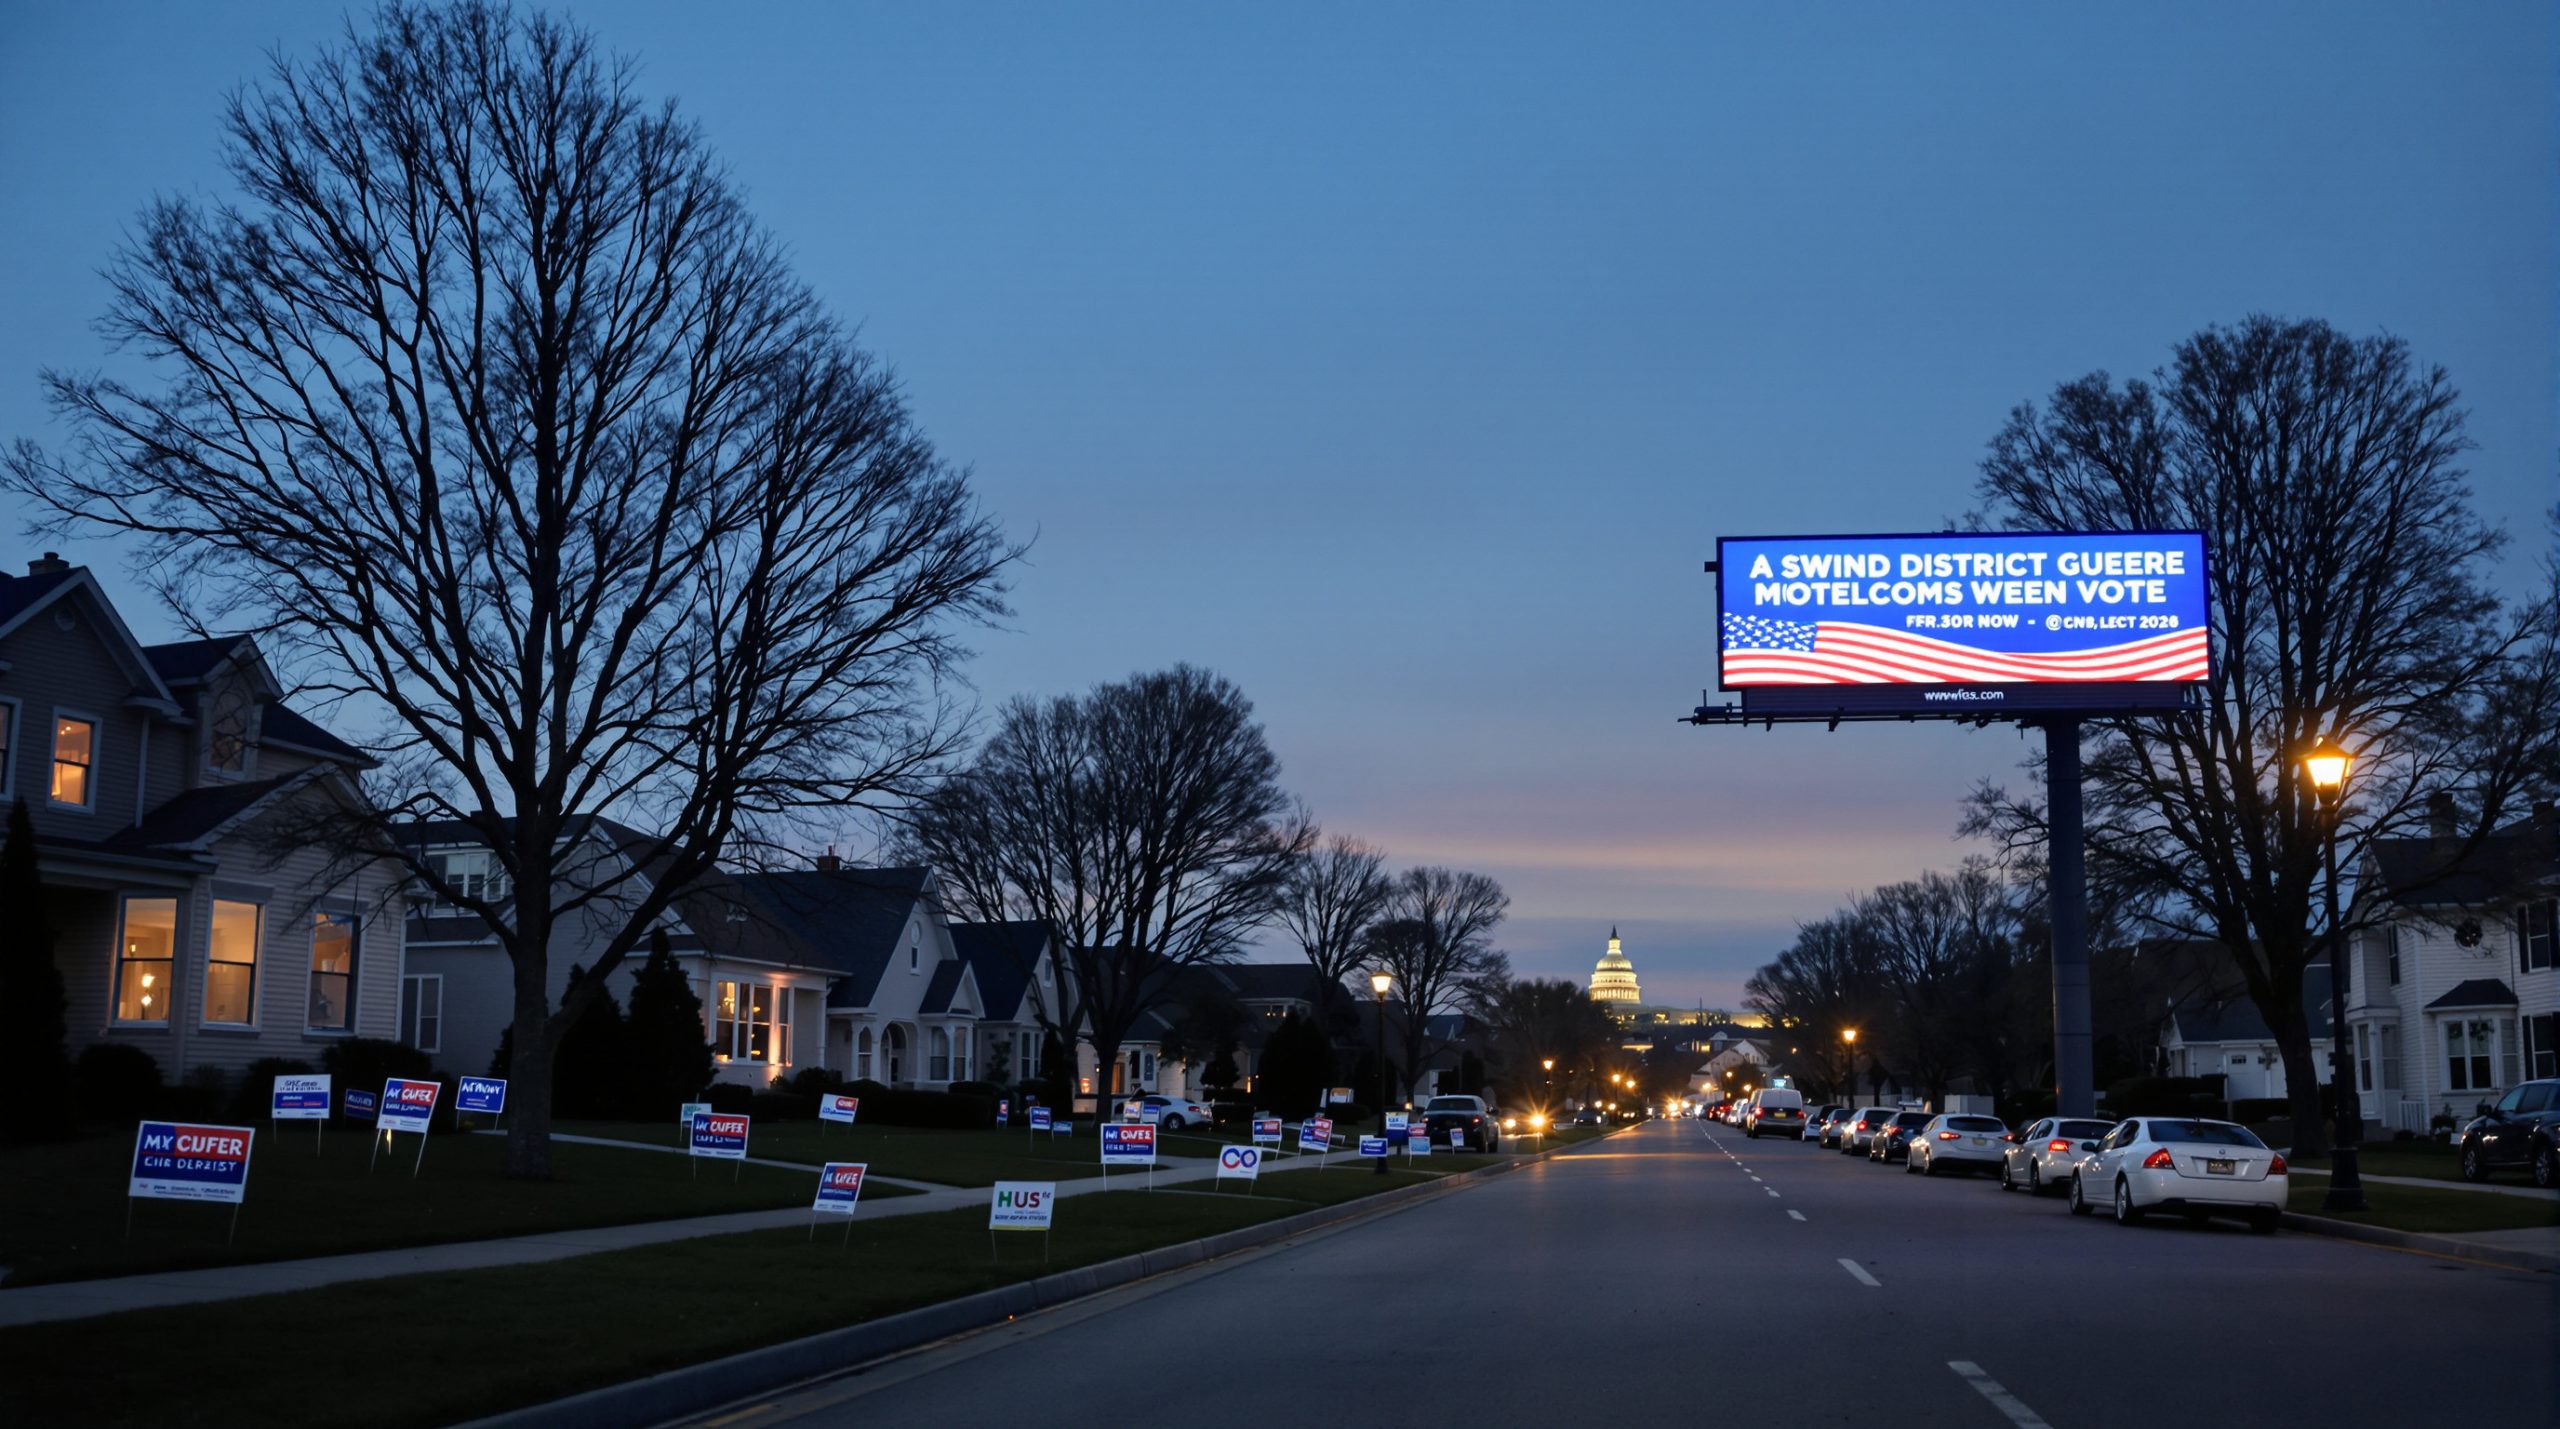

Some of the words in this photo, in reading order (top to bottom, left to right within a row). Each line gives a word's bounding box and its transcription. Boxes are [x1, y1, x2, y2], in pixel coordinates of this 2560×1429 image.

[1749, 553, 1774, 579] A
[1780, 553, 1892, 579] SWIND
[1900, 552, 2048, 578] DISTRICT
[2056, 551, 2186, 577] GUEERE
[1970, 580, 2067, 605] WEEN
[2076, 579, 2167, 604] VOTE
[1978, 614, 2019, 629] NOW
[176, 1134, 244, 1157] CUFER
[998, 1190, 1040, 1208] HUS
